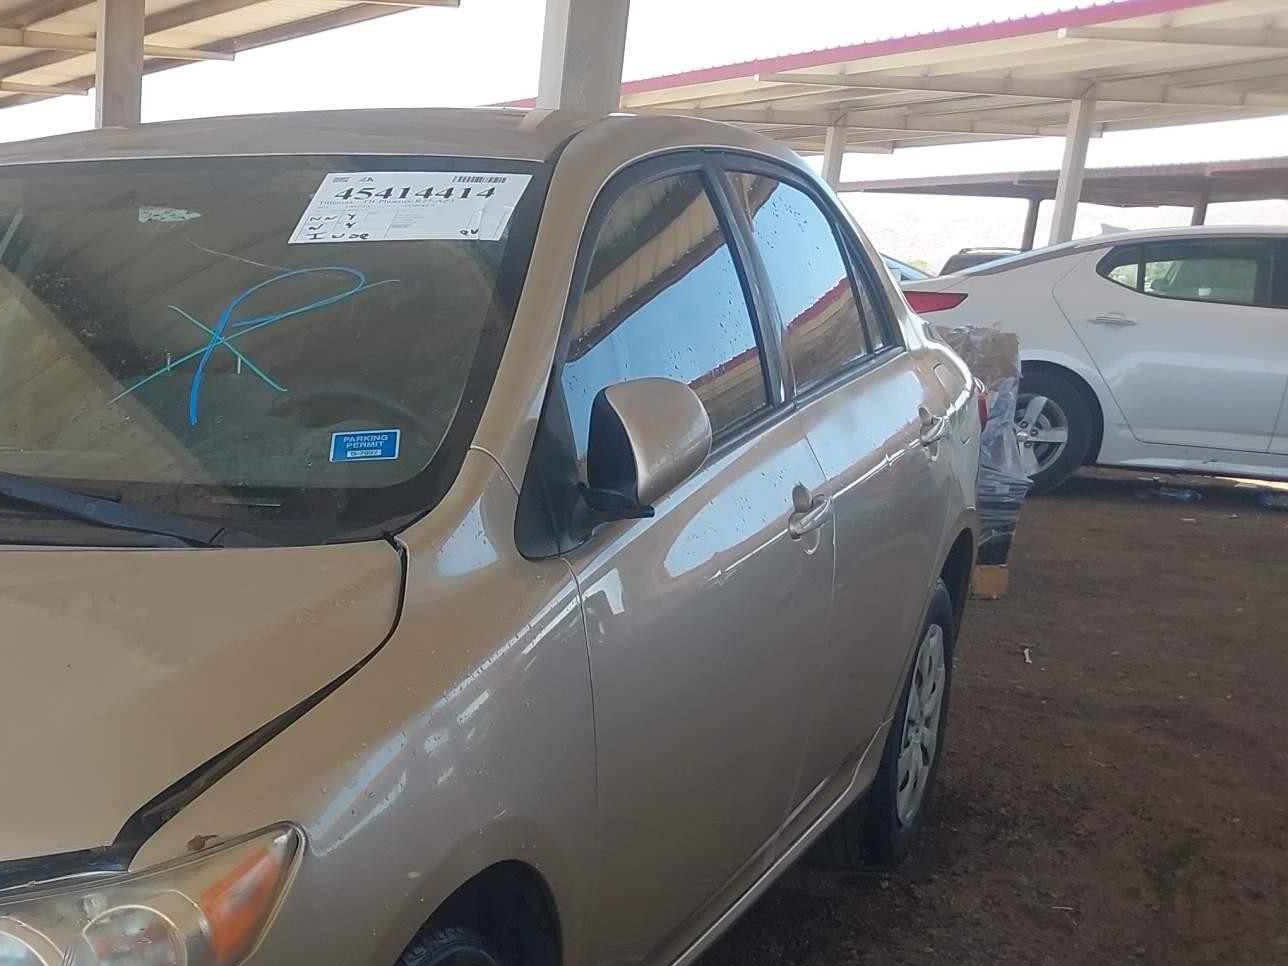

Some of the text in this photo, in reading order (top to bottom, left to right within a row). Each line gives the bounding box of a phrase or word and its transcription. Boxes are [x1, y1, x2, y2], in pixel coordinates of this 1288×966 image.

[333, 186, 496, 200] 45414414
[344, 434, 388, 442] PARKING
[346, 441, 384, 449] PERMIT
